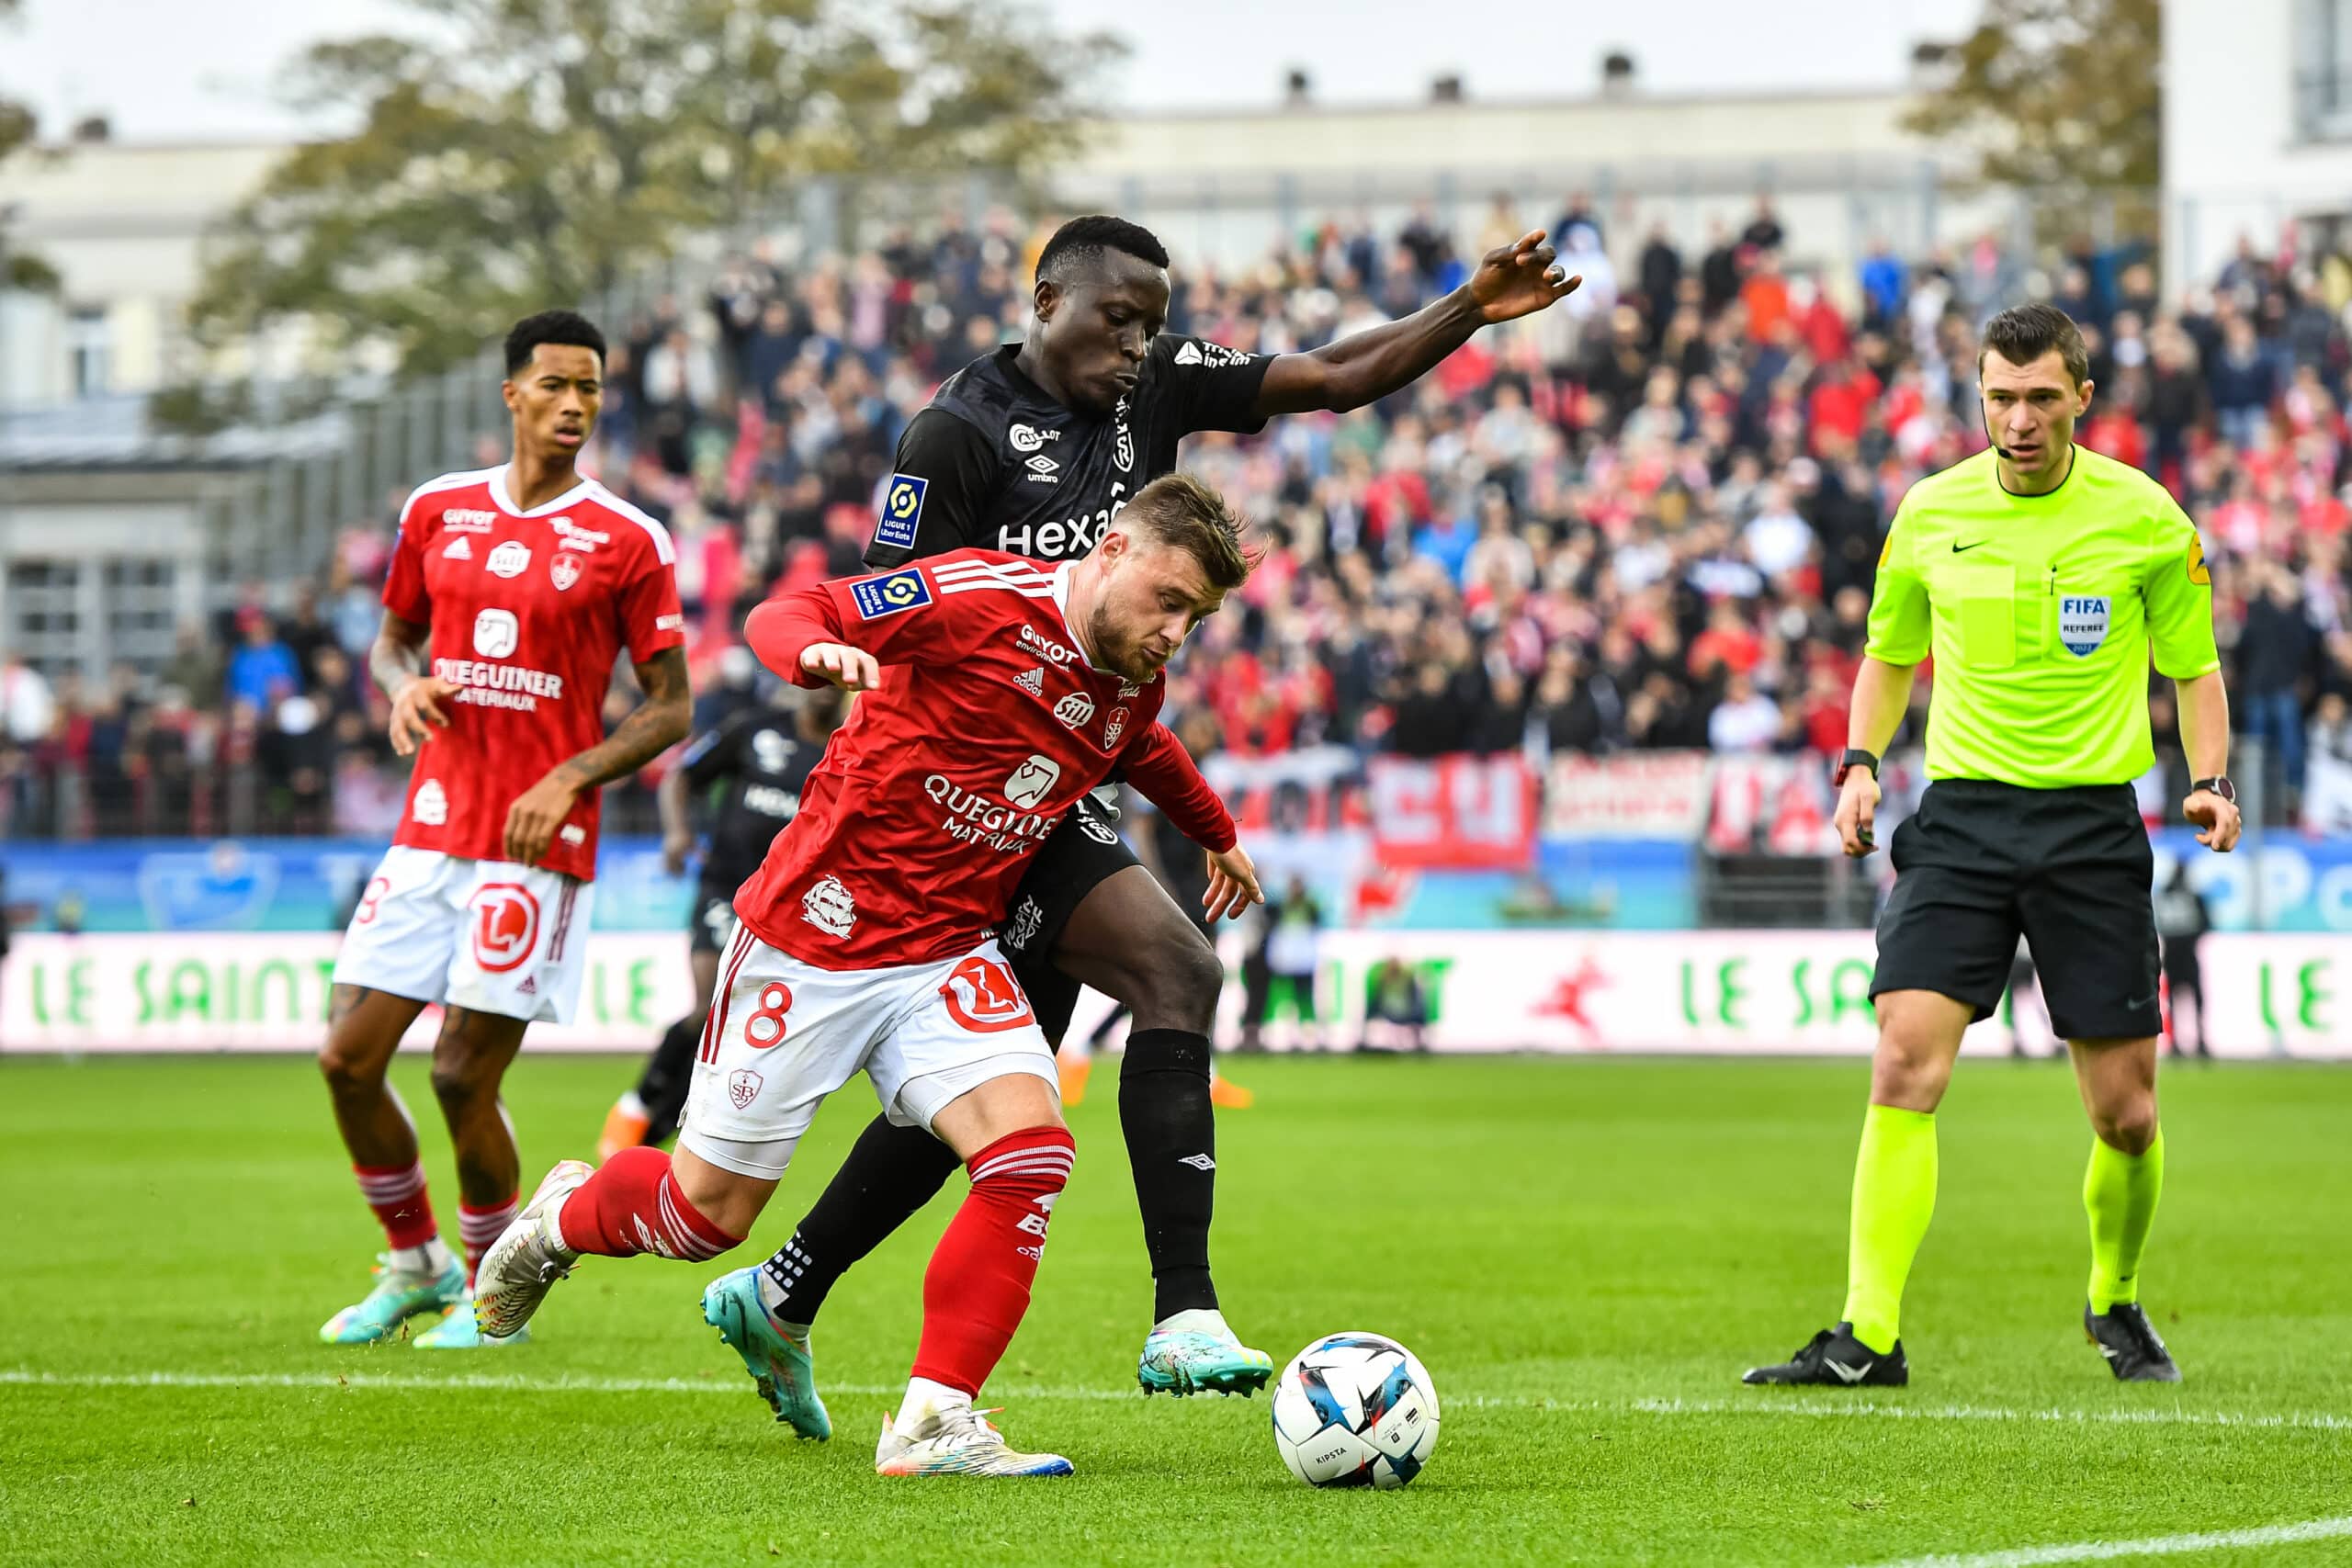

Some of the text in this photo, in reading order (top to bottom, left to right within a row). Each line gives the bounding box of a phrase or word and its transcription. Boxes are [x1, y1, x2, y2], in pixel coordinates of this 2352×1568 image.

[1027, 473, 1058, 483] umbro
[443, 509, 497, 525] GUYOT
[884, 519, 906, 530] LIGUE
[2064, 599, 2106, 615] FIFA
[2063, 624, 2105, 633] REFEREE
[1021, 624, 1080, 664] GUYOT
[1012, 675, 1043, 697] adidas
[1056, 699, 1091, 724] Sill
[31, 959, 96, 1026] LE
[591, 957, 655, 1027] LE
[1681, 958, 1747, 1029] LE
[2259, 958, 2335, 1032] LE
[744, 981, 793, 1049] 8
[1315, 1447, 1348, 1465] KIPSTA
